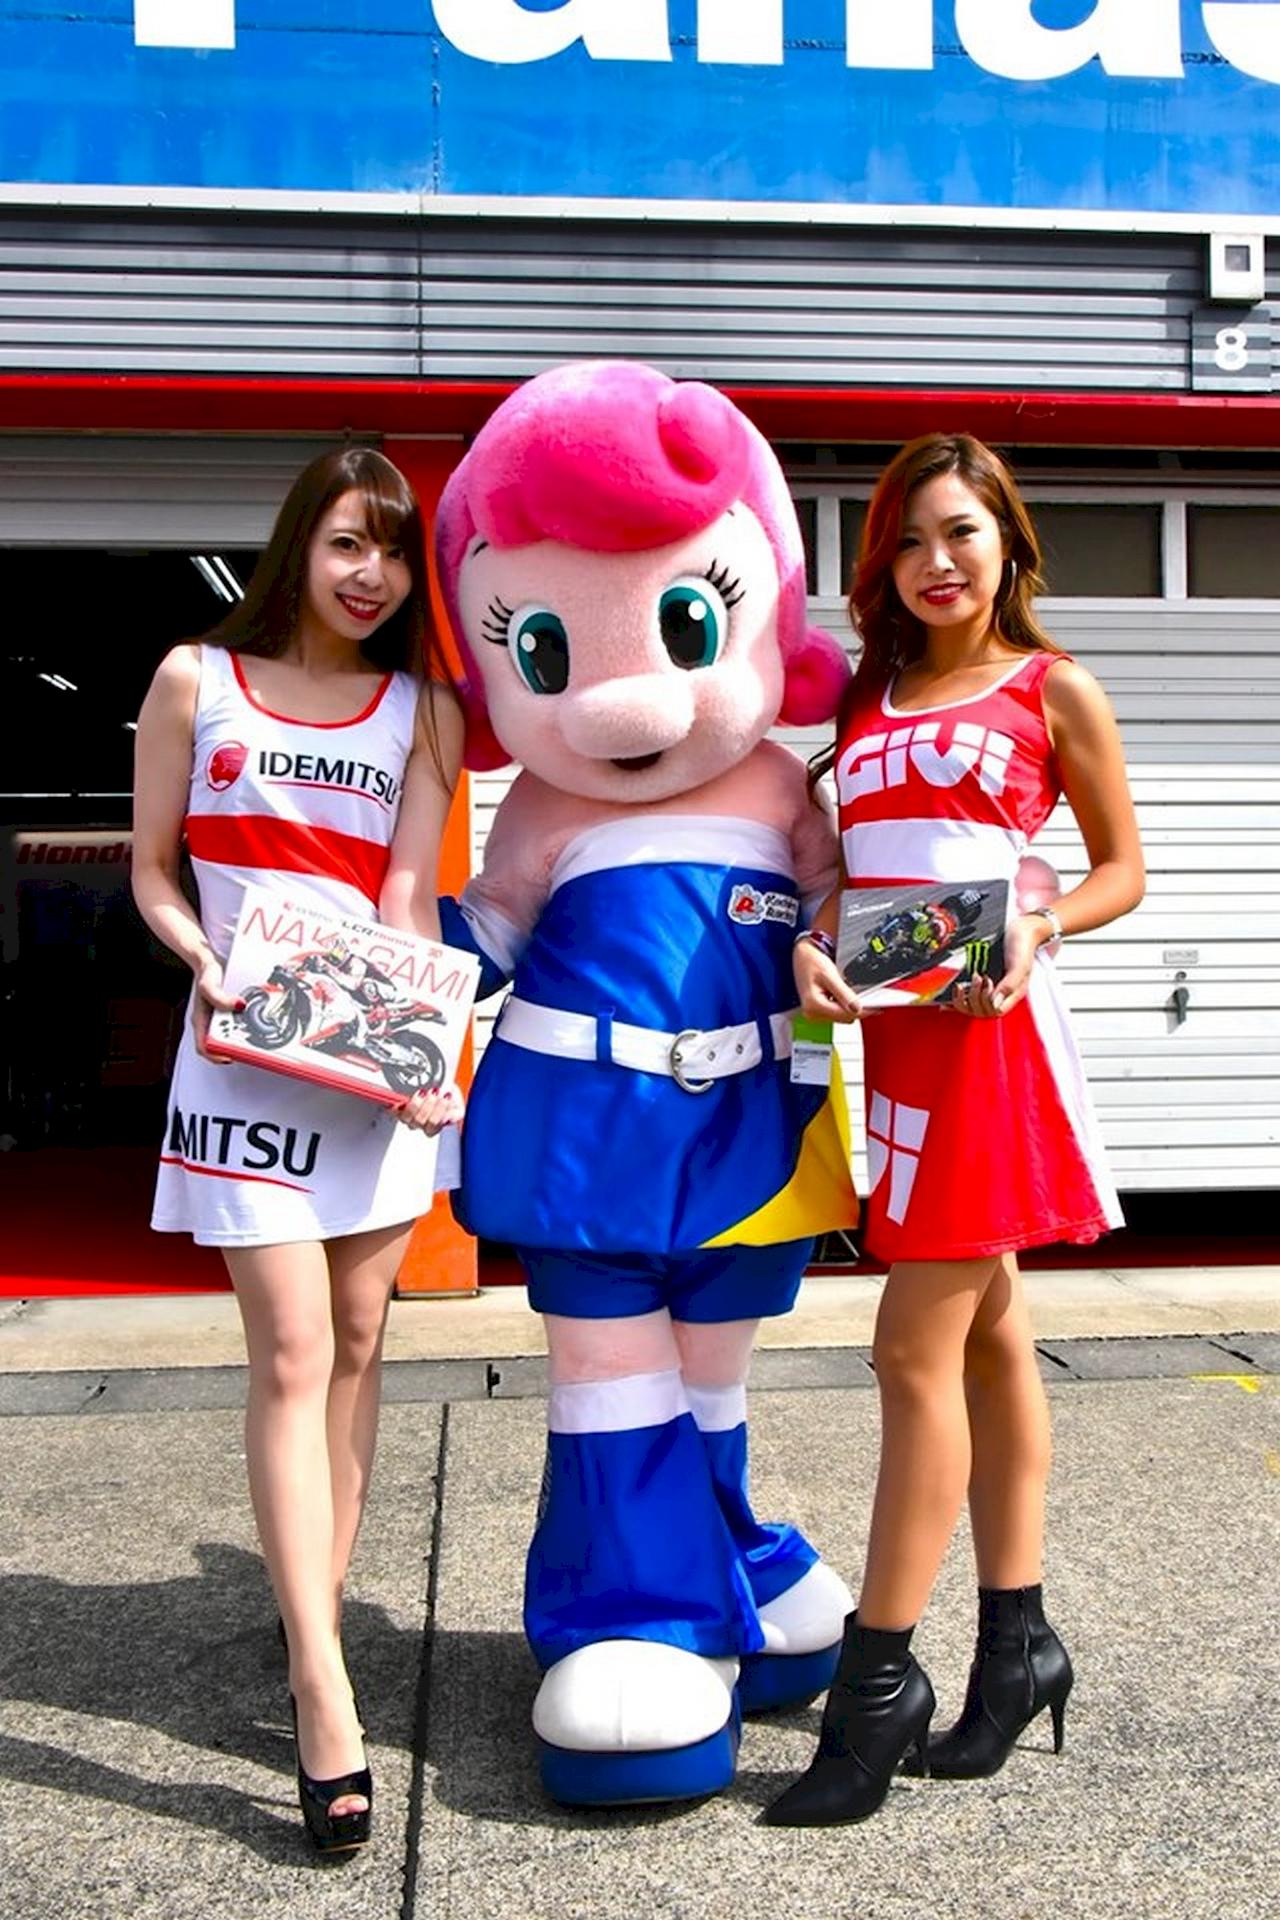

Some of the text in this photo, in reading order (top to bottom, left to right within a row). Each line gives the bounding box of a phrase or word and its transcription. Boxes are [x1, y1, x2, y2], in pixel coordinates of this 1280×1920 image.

[1214, 328, 1248, 371] 8
[259, 751, 398, 805] IDEMITSU
[836, 722, 1015, 806] GIVI
[243, 906, 470, 1001] NAKGAMI
